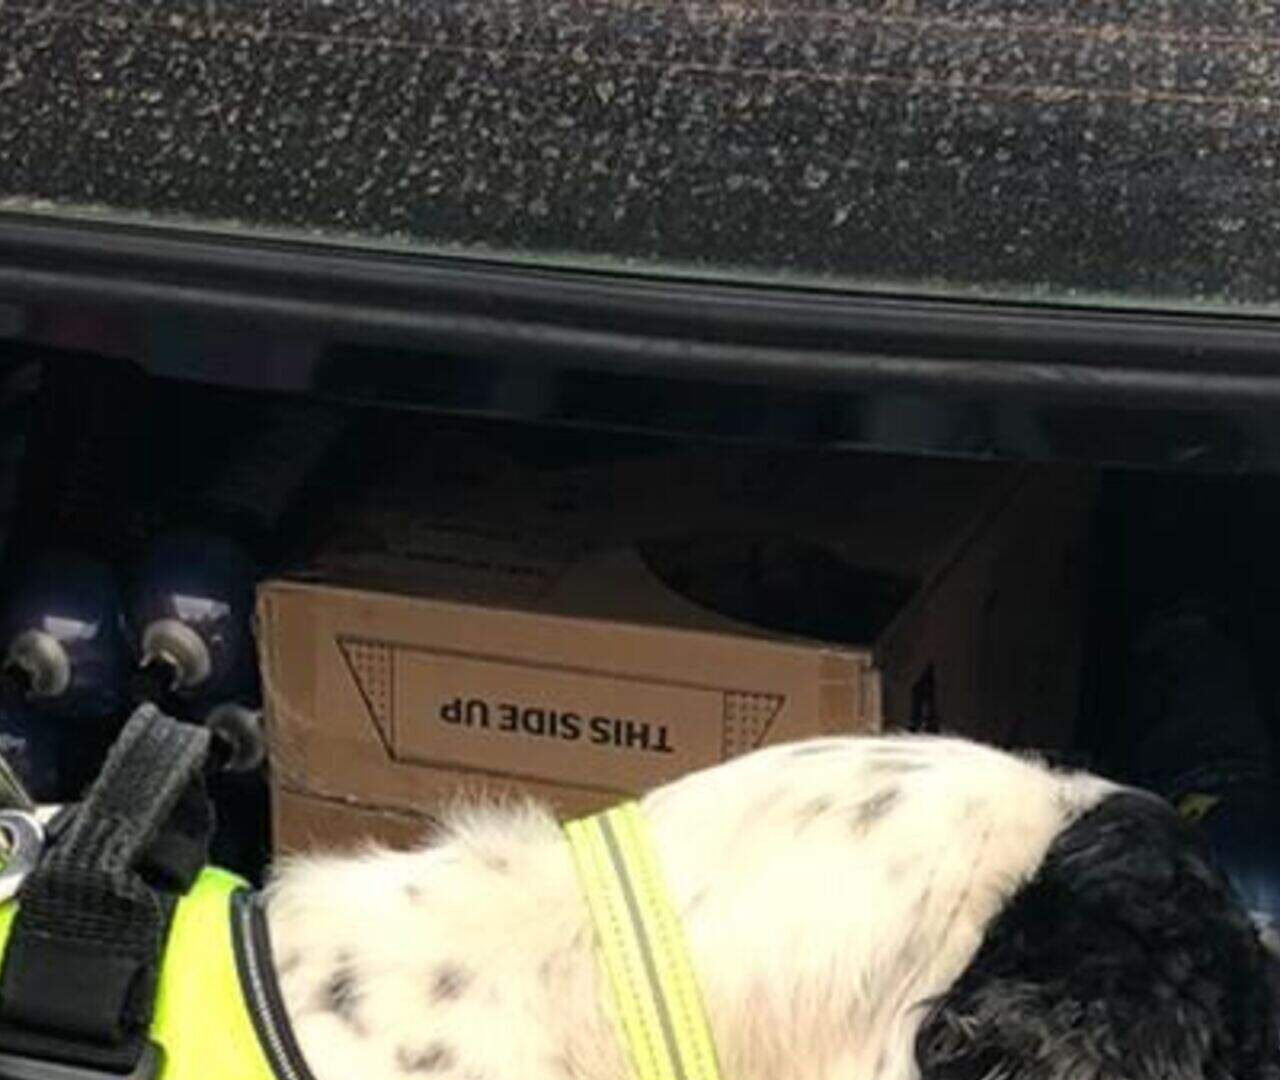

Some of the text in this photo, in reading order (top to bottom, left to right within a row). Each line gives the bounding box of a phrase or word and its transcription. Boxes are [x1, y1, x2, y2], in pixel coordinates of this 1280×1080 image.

[439, 695, 675, 754] THIS SIDE UP
